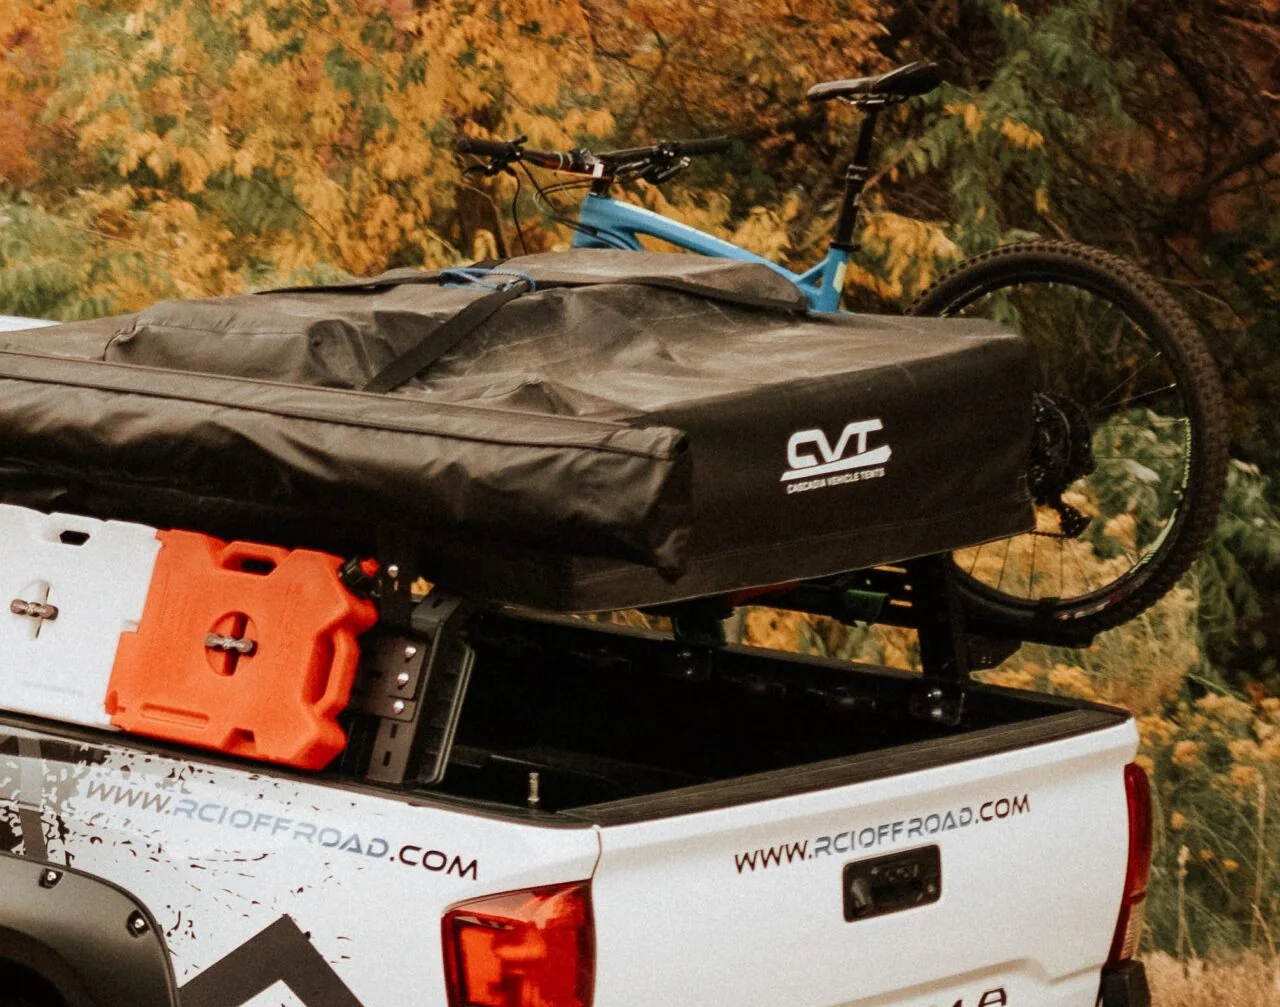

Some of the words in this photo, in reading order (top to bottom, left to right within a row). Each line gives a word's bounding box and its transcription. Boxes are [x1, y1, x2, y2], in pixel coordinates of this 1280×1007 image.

[787, 418, 883, 469] CVT
[86, 779, 479, 881] WWW.RCIOFFROAD.COM
[734, 794, 1031, 874] WWW.RCIOFFROAD.COM
